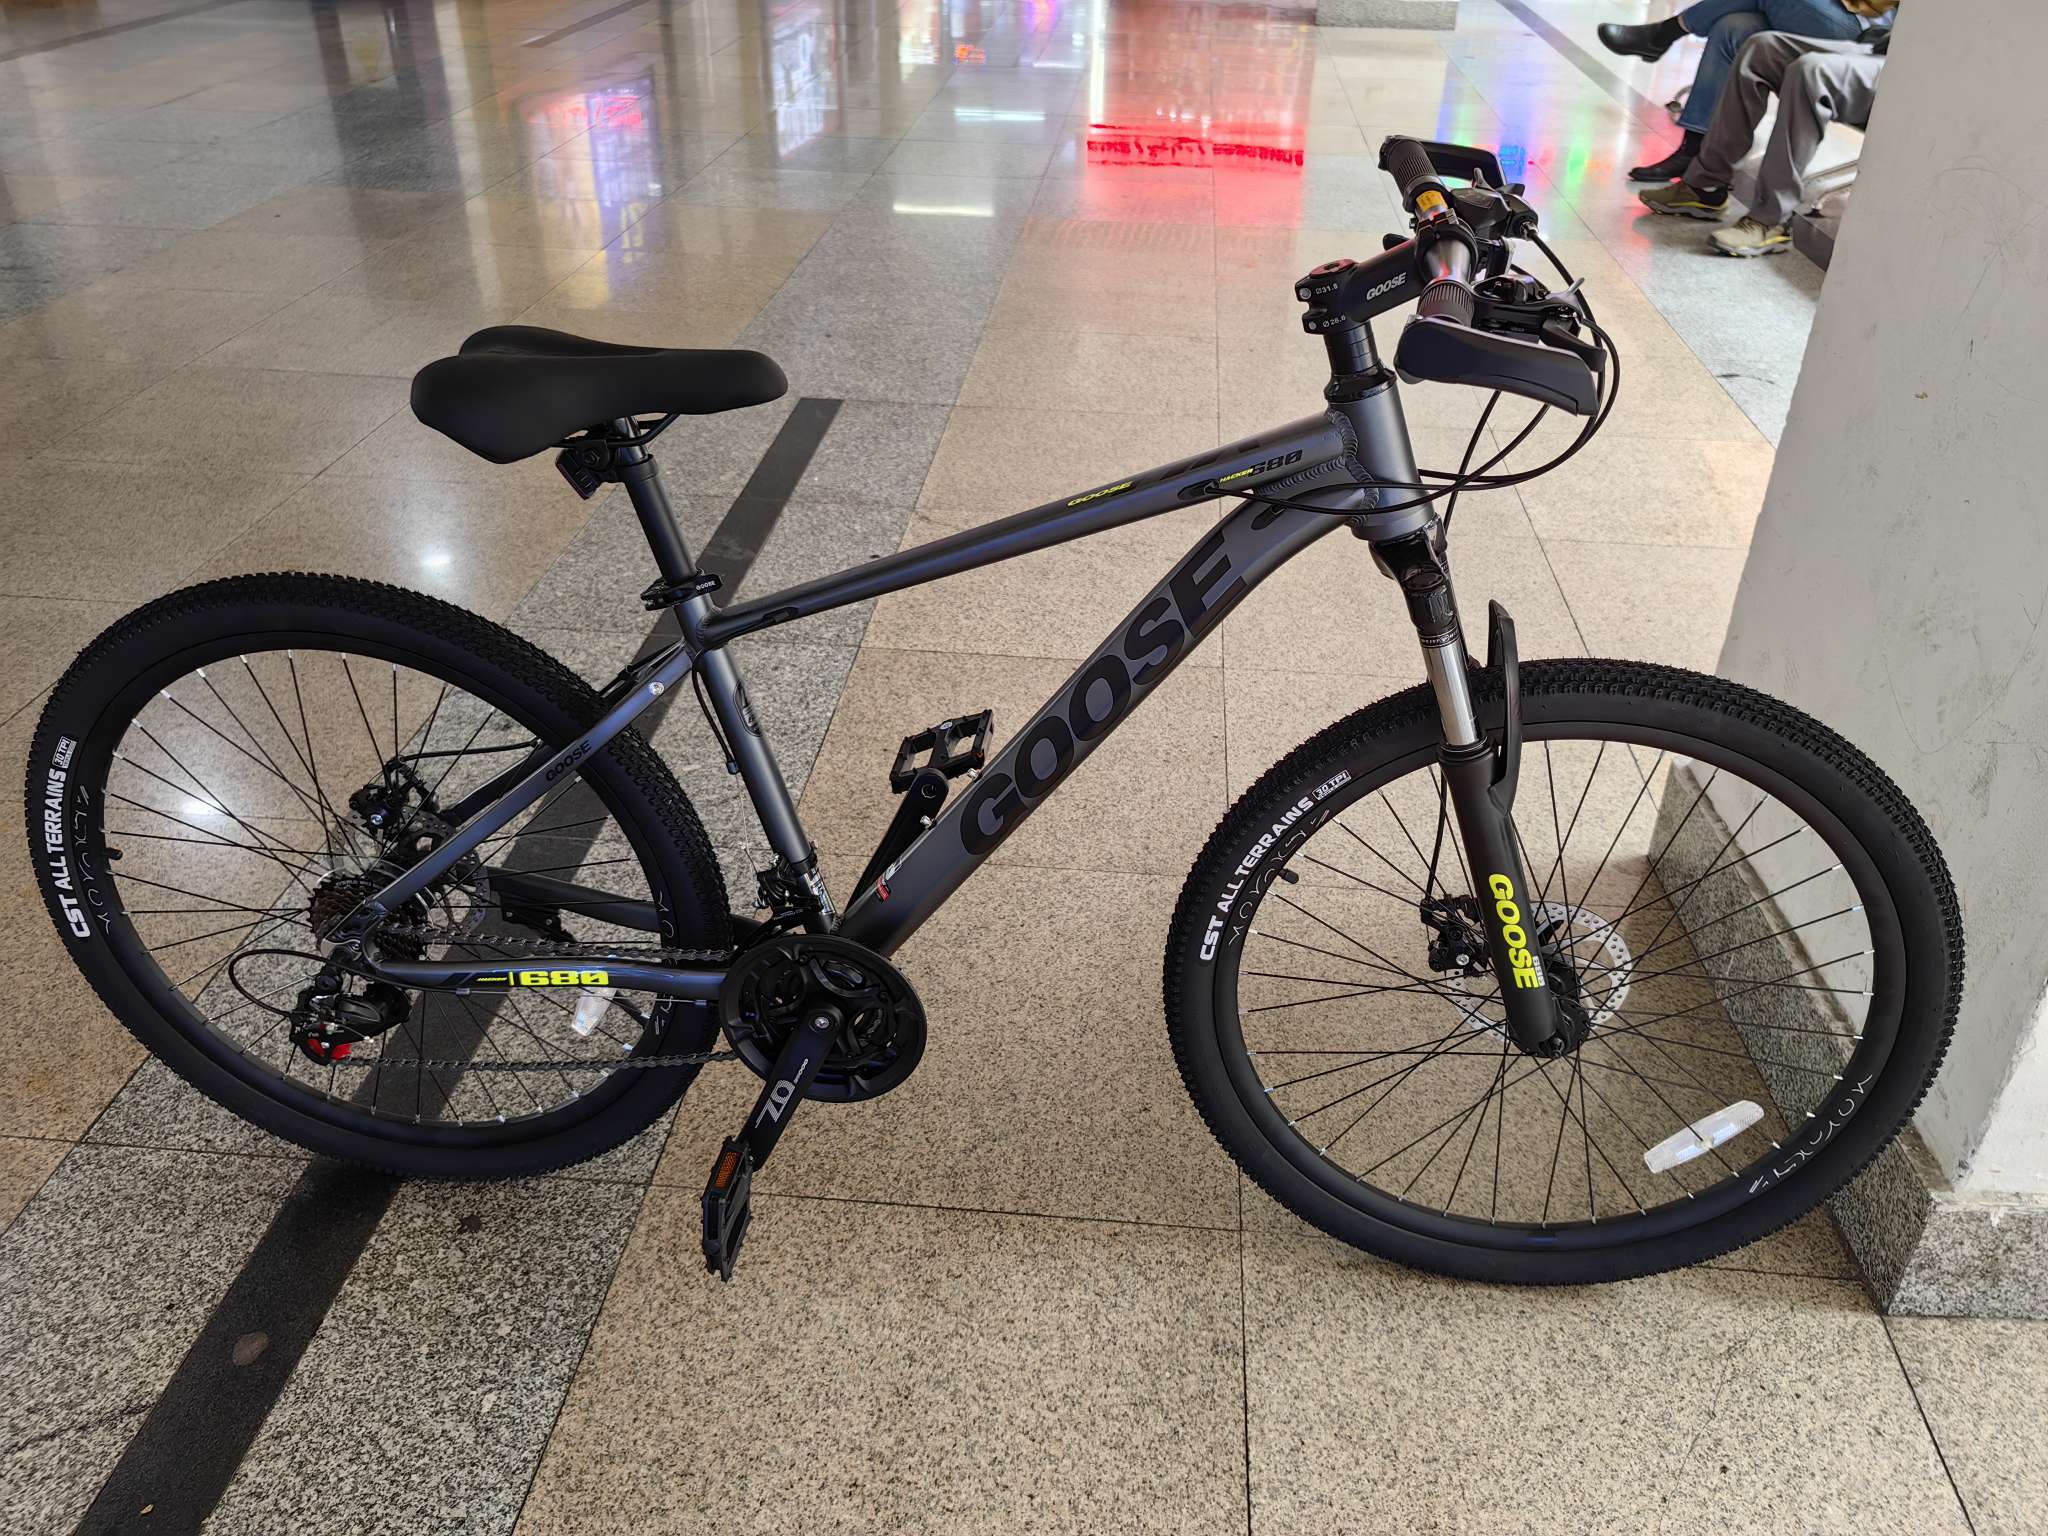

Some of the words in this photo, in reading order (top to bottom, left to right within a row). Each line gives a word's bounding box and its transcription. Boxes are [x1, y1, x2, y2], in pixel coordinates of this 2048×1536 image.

[1366, 271, 1407, 301] GOOSE
[1067, 480, 1134, 507] GOOSE
[960, 530, 1248, 856] GOOSE
[545, 738, 592, 782] GOOSE
[44, 768, 67, 854] TERRAINS
[51, 855, 74, 891] ALL
[1199, 914, 1224, 962] CST
[1216, 875, 1245, 913] ALL
[1234, 795, 1315, 876] TERRAINS
[59, 894, 91, 938] CST
[1488, 873, 1541, 989] GOOSE
[519, 970, 609, 986] 680
